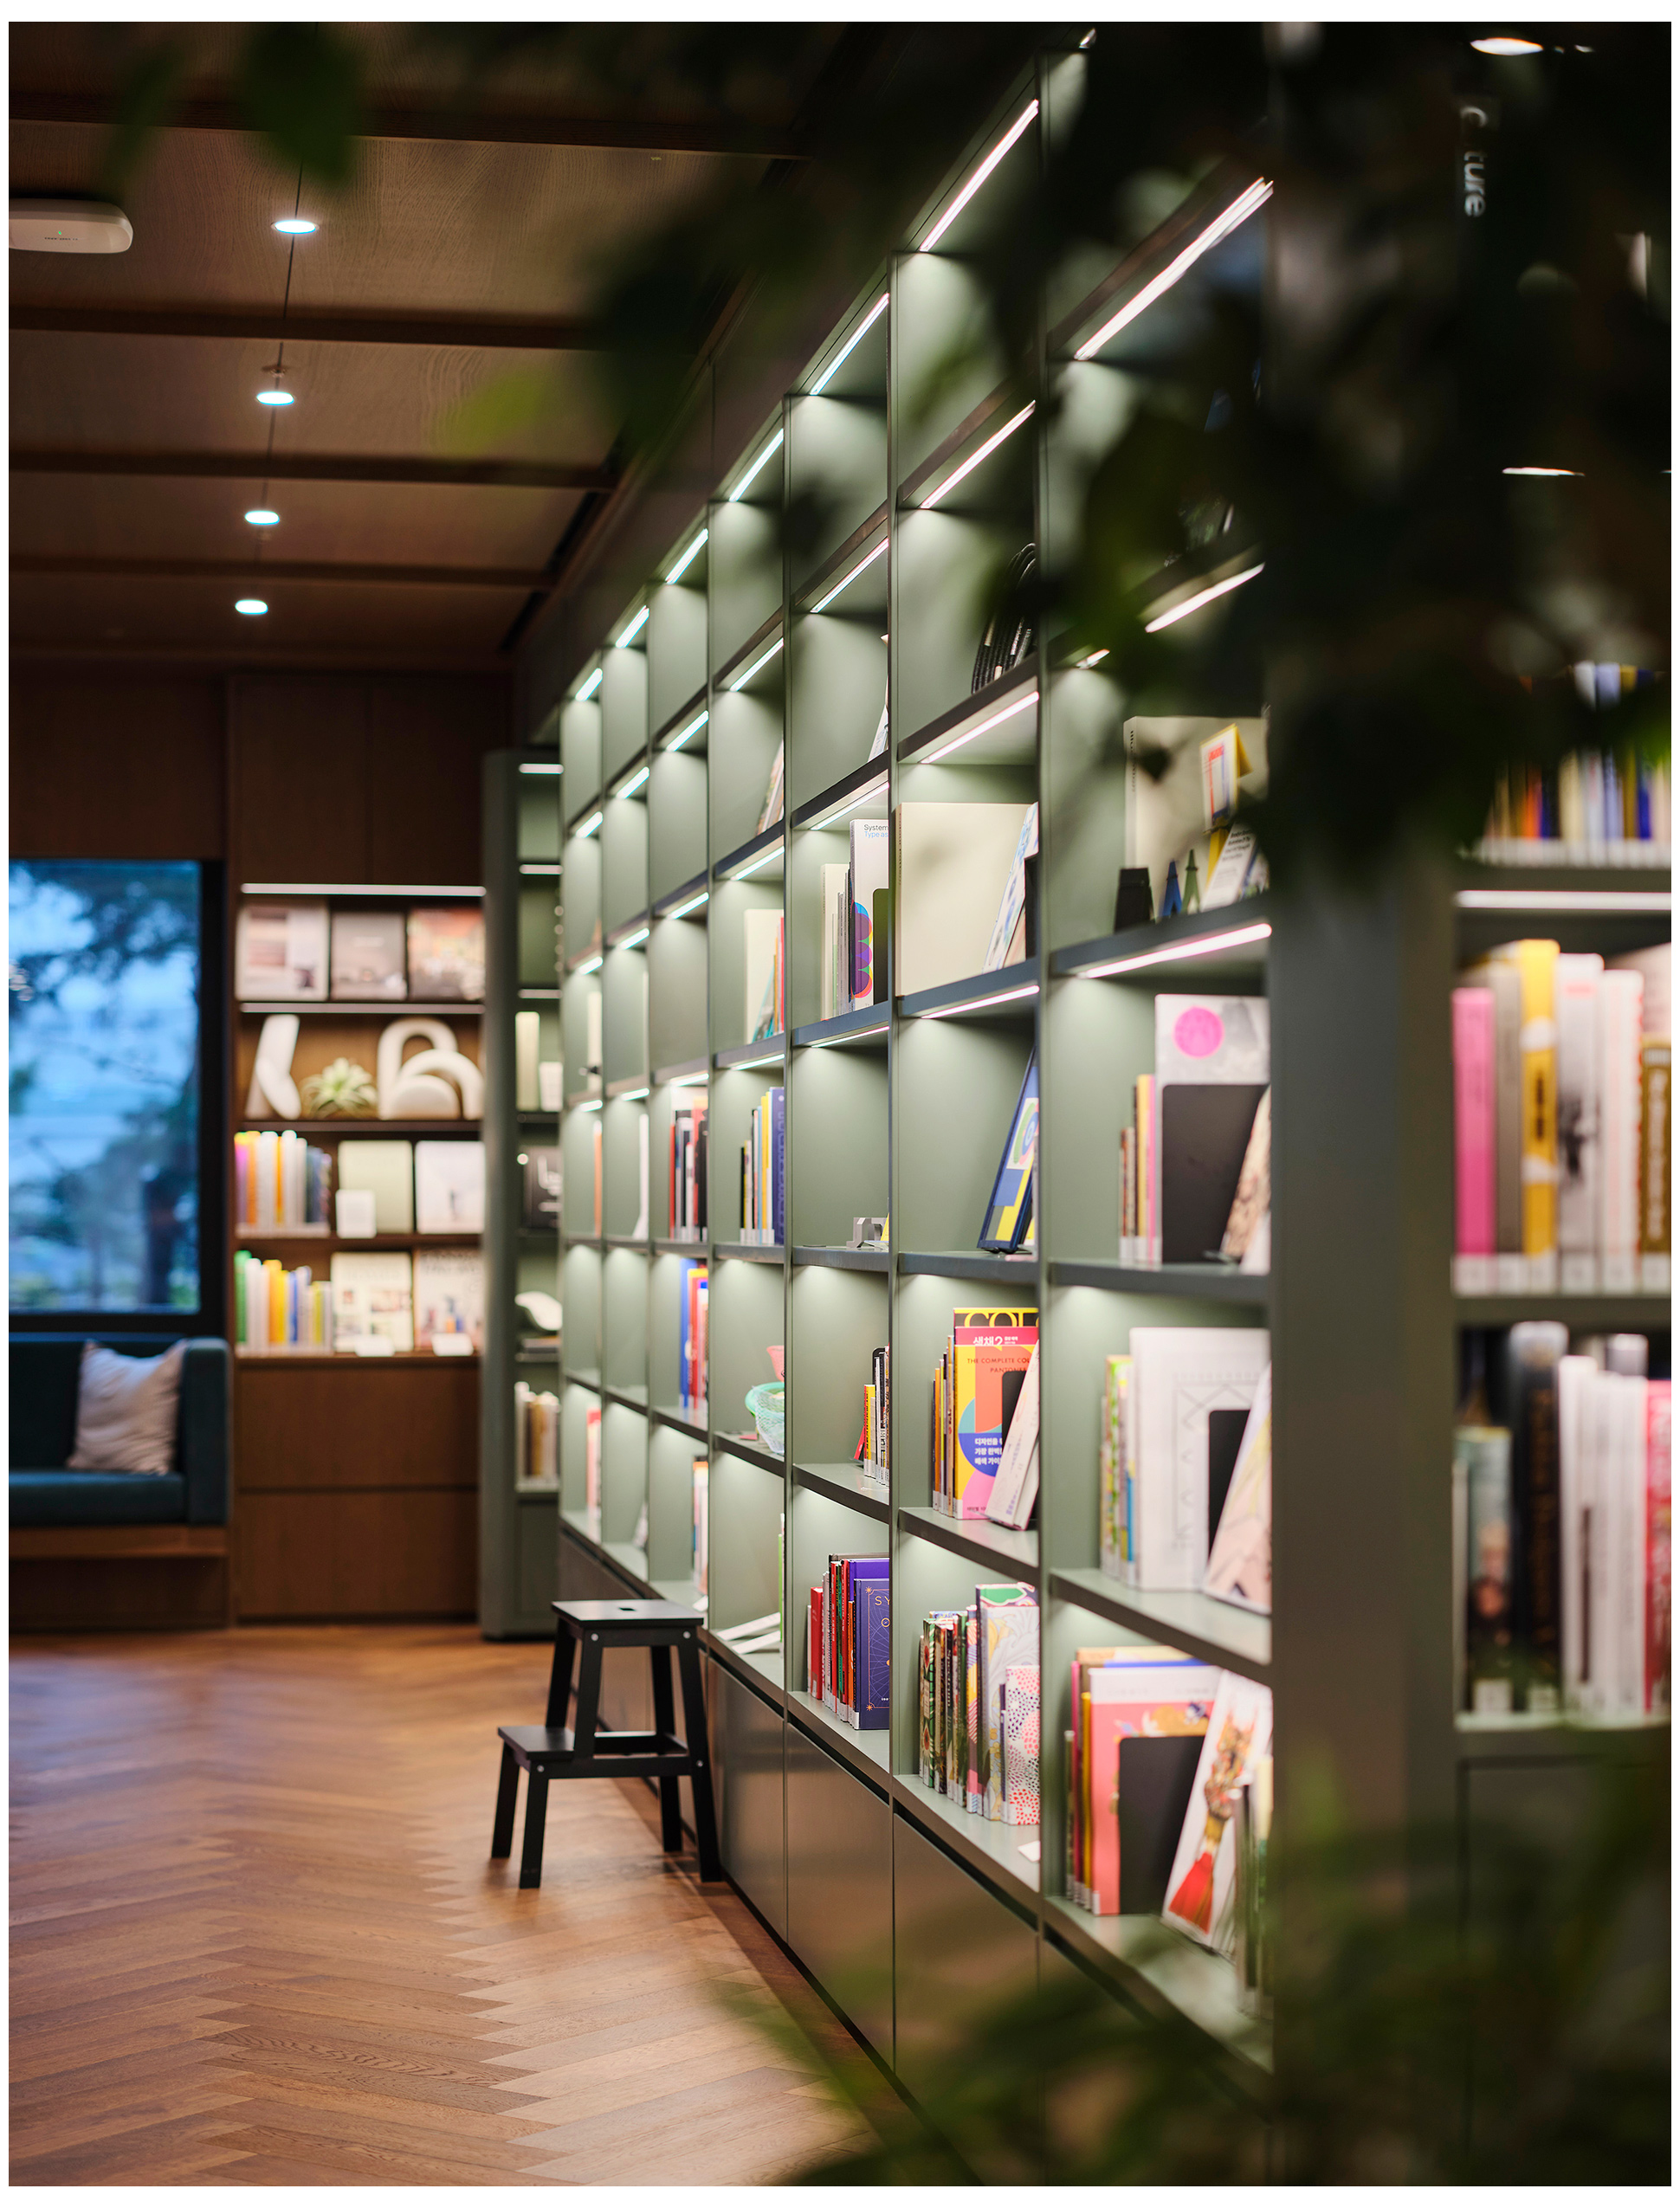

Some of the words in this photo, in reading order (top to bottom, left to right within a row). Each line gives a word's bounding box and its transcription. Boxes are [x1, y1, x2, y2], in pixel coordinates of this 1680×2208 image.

[1460, 106, 1489, 216] Cture
[974, 1437, 998, 1446] 디자인을
[974, 1447, 987, 1456] 가장
[987, 1447, 1003, 1456] 완벽
